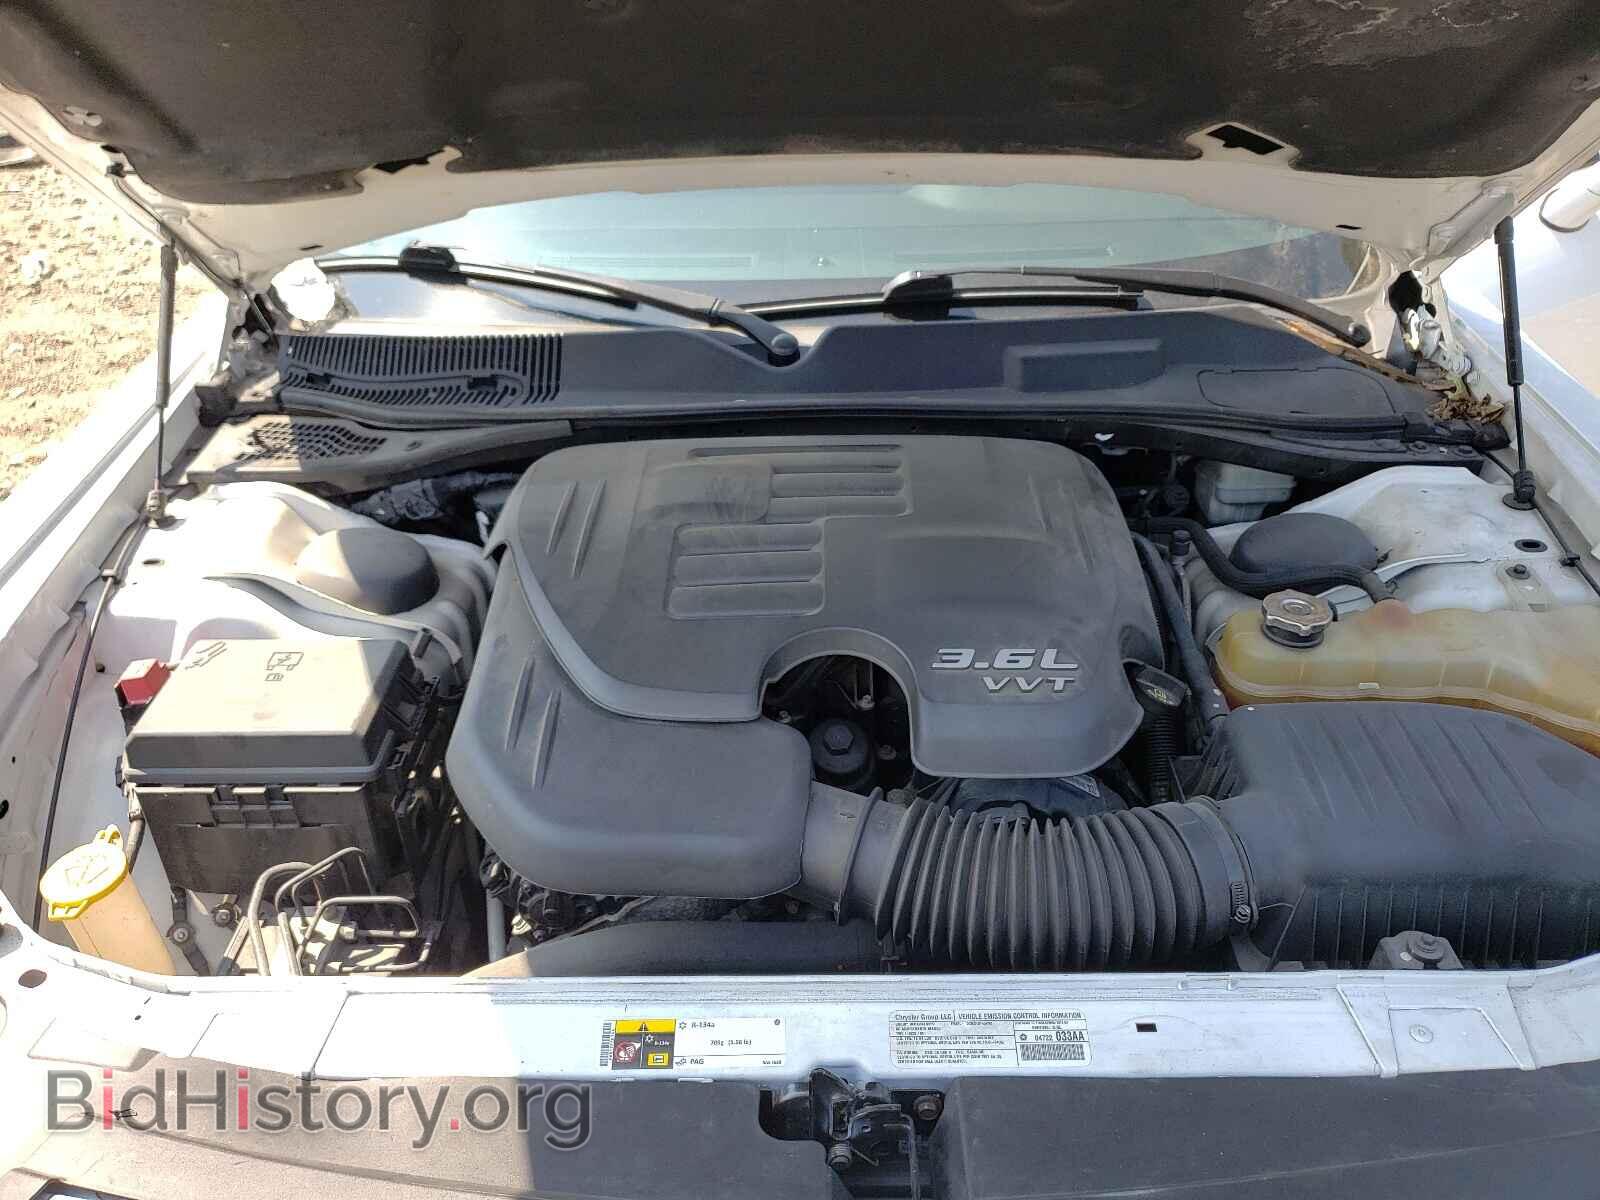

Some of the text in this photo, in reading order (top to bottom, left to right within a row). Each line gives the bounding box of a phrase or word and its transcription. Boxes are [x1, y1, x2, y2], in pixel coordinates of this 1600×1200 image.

[931, 648, 1078, 670] 3.6L
[982, 676, 1076, 692] VVT
[958, 1012, 982, 1020] VEHICLE
[983, 1012, 1012, 1020] EMISSION
[1055, 1030, 1085, 1041] 033AA
